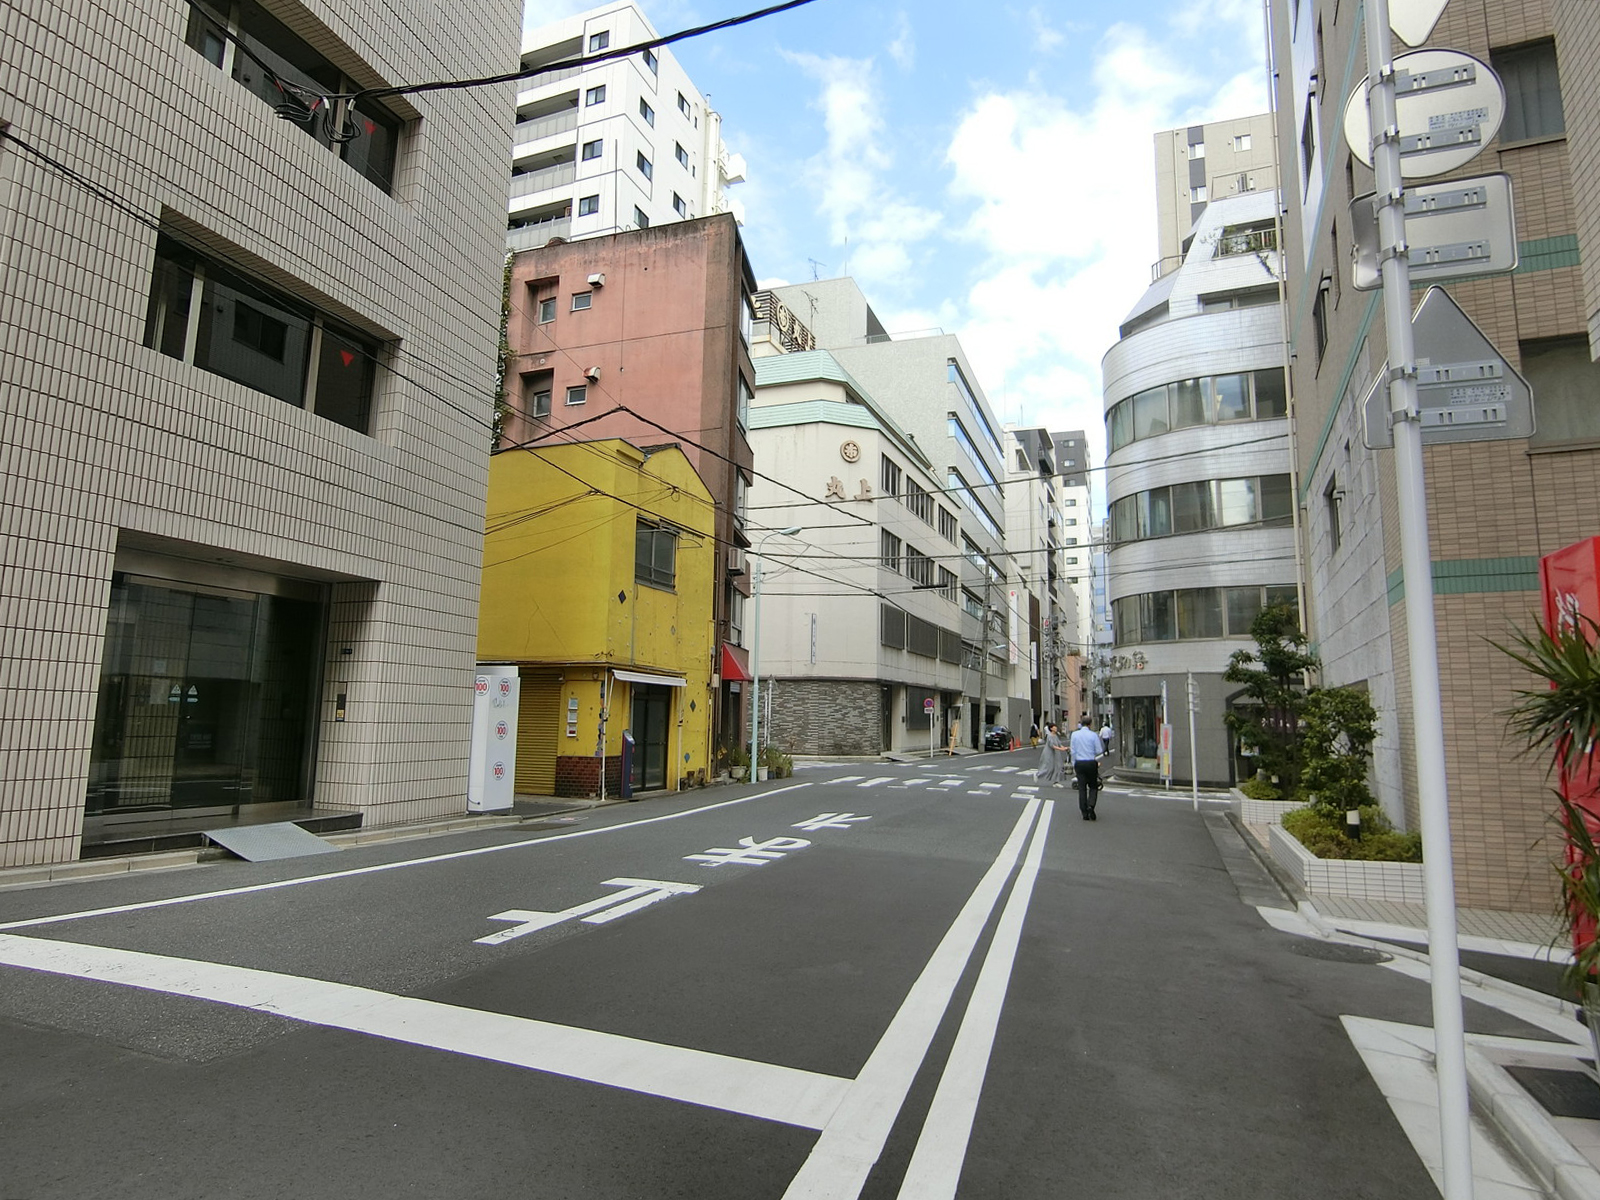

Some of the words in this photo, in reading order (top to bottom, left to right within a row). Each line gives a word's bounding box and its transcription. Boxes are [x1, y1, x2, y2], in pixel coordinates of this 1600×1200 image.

[825, 475, 873, 503] 丸上
[500, 683, 509, 692] 100
[497, 726, 506, 735] 100
[494, 767, 503, 776] 100
[473, 812, 872, 945] 止まれ
